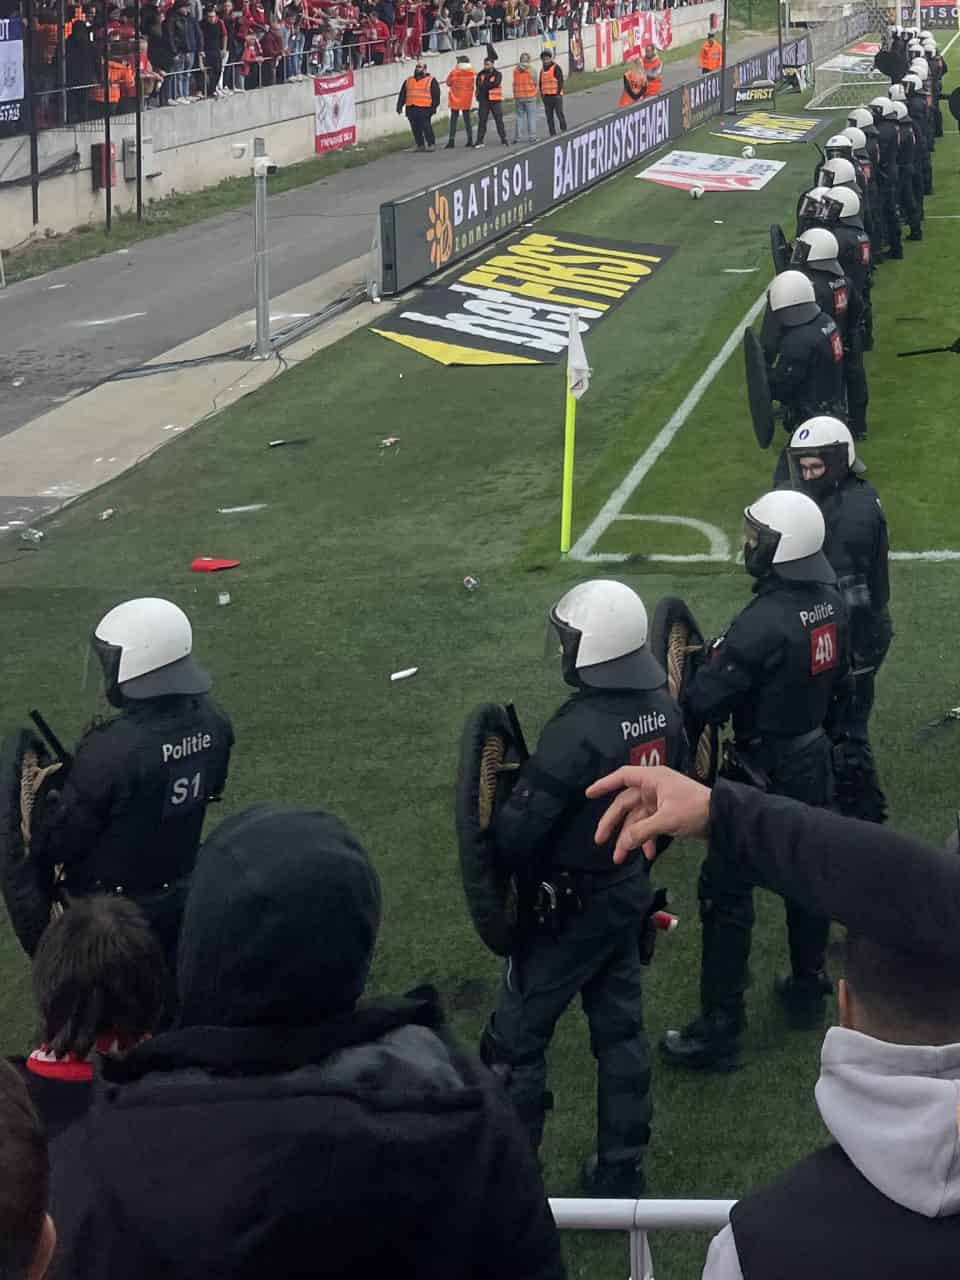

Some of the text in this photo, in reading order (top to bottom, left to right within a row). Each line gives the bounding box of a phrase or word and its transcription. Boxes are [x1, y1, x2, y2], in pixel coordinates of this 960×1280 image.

[553, 98, 670, 199] BATTERIJSYSTEMEN
[800, 602, 834, 627] Politie
[815, 633, 833, 664] 40
[621, 712, 667, 740] Politie
[162, 732, 211, 762] Politie
[171, 772, 201, 805] S1
